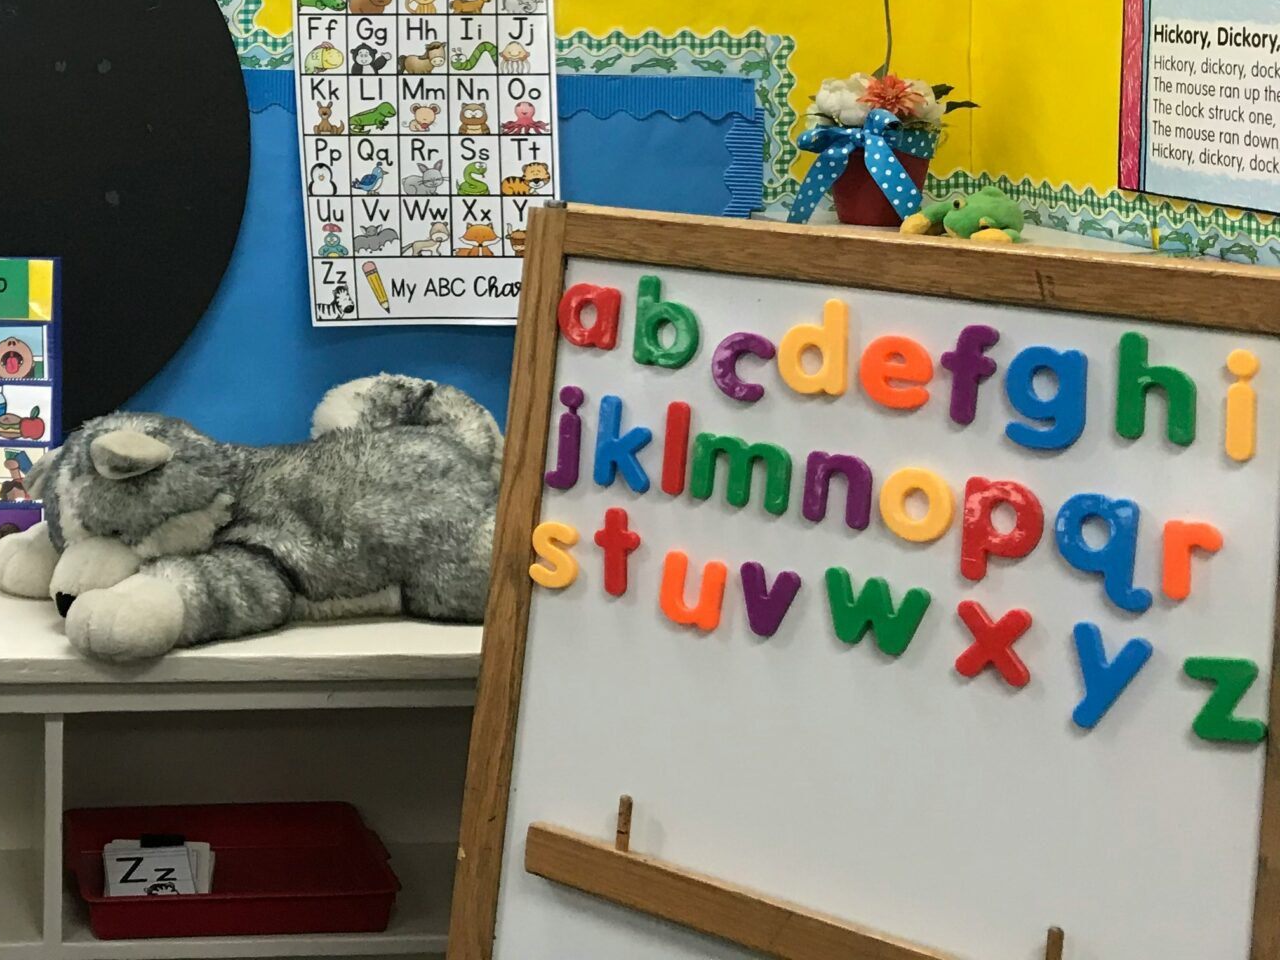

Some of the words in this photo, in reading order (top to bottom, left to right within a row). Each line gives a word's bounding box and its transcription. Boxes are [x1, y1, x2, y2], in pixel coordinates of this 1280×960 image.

[308, 17, 338, 40] Ff
[356, 18, 388, 45] Gg
[406, 17, 438, 40] Hh
[461, 18, 482, 40] Ii
[508, 18, 534, 46] Jj
[1154, 24, 1211, 49] Hickory,
[1217, 26, 1280, 53] Dickory,
[1154, 55, 1196, 76] Hickory,
[1201, 58, 1246, 80] dickory,
[311, 78, 339, 101] Kk
[360, 78, 382, 100] Ll
[402, 78, 445, 100] Mm
[457, 78, 489, 100] Nn
[508, 78, 541, 100] Oo
[1154, 77, 1172, 92] The
[1176, 83, 1216, 96] mouse
[1220, 85, 1239, 99] ran
[1244, 88, 1260, 104] up
[1153, 99, 1172, 114] The
[1176, 101, 1204, 118] clock
[1209, 103, 1244, 123] struck
[1249, 111, 1276, 128] one,
[1153, 120, 1171, 136] The
[1175, 127, 1215, 140] mouse
[1219, 131, 1239, 144] ran
[315, 139, 342, 166] Pp
[357, 139, 392, 165] Qq
[411, 139, 439, 161] Rr
[461, 139, 489, 161] Ss
[510, 139, 541, 161] Tt
[1152, 143, 1195, 166] Hickory,
[1199, 148, 1244, 172] dickory,
[317, 201, 344, 222] Uu
[363, 200, 389, 221] Vv
[402, 199, 448, 221] Ww
[462, 199, 491, 222] Xx
[512, 198, 528, 222] Y
[322, 262, 347, 284] Zz
[391, 279, 416, 298] My
[424, 278, 466, 297] ABC
[474, 276, 520, 297] Cha
